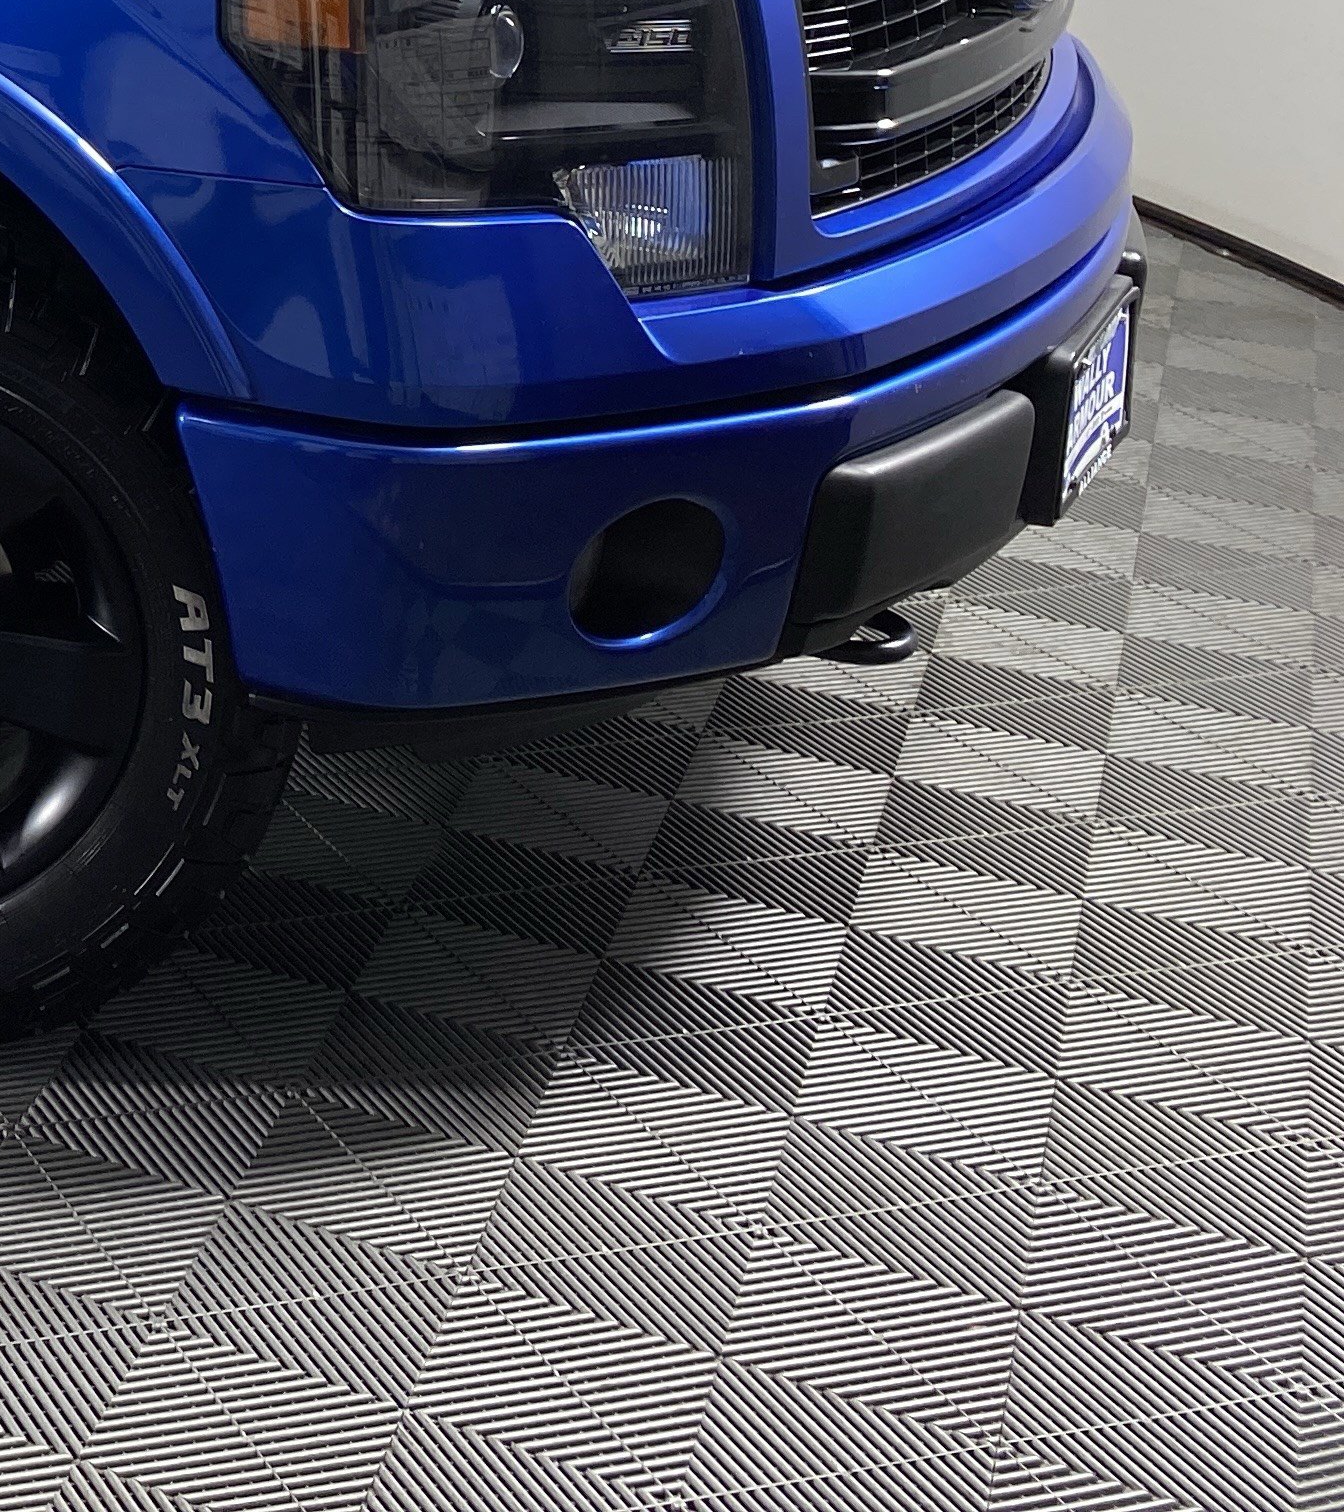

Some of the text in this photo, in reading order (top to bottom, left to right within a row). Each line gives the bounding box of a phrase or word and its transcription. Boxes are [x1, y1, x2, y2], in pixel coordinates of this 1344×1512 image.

[1065, 369, 1116, 457] ARMOUR
[1073, 339, 1113, 412] WALLY
[166, 584, 215, 813] AT3 XLT
